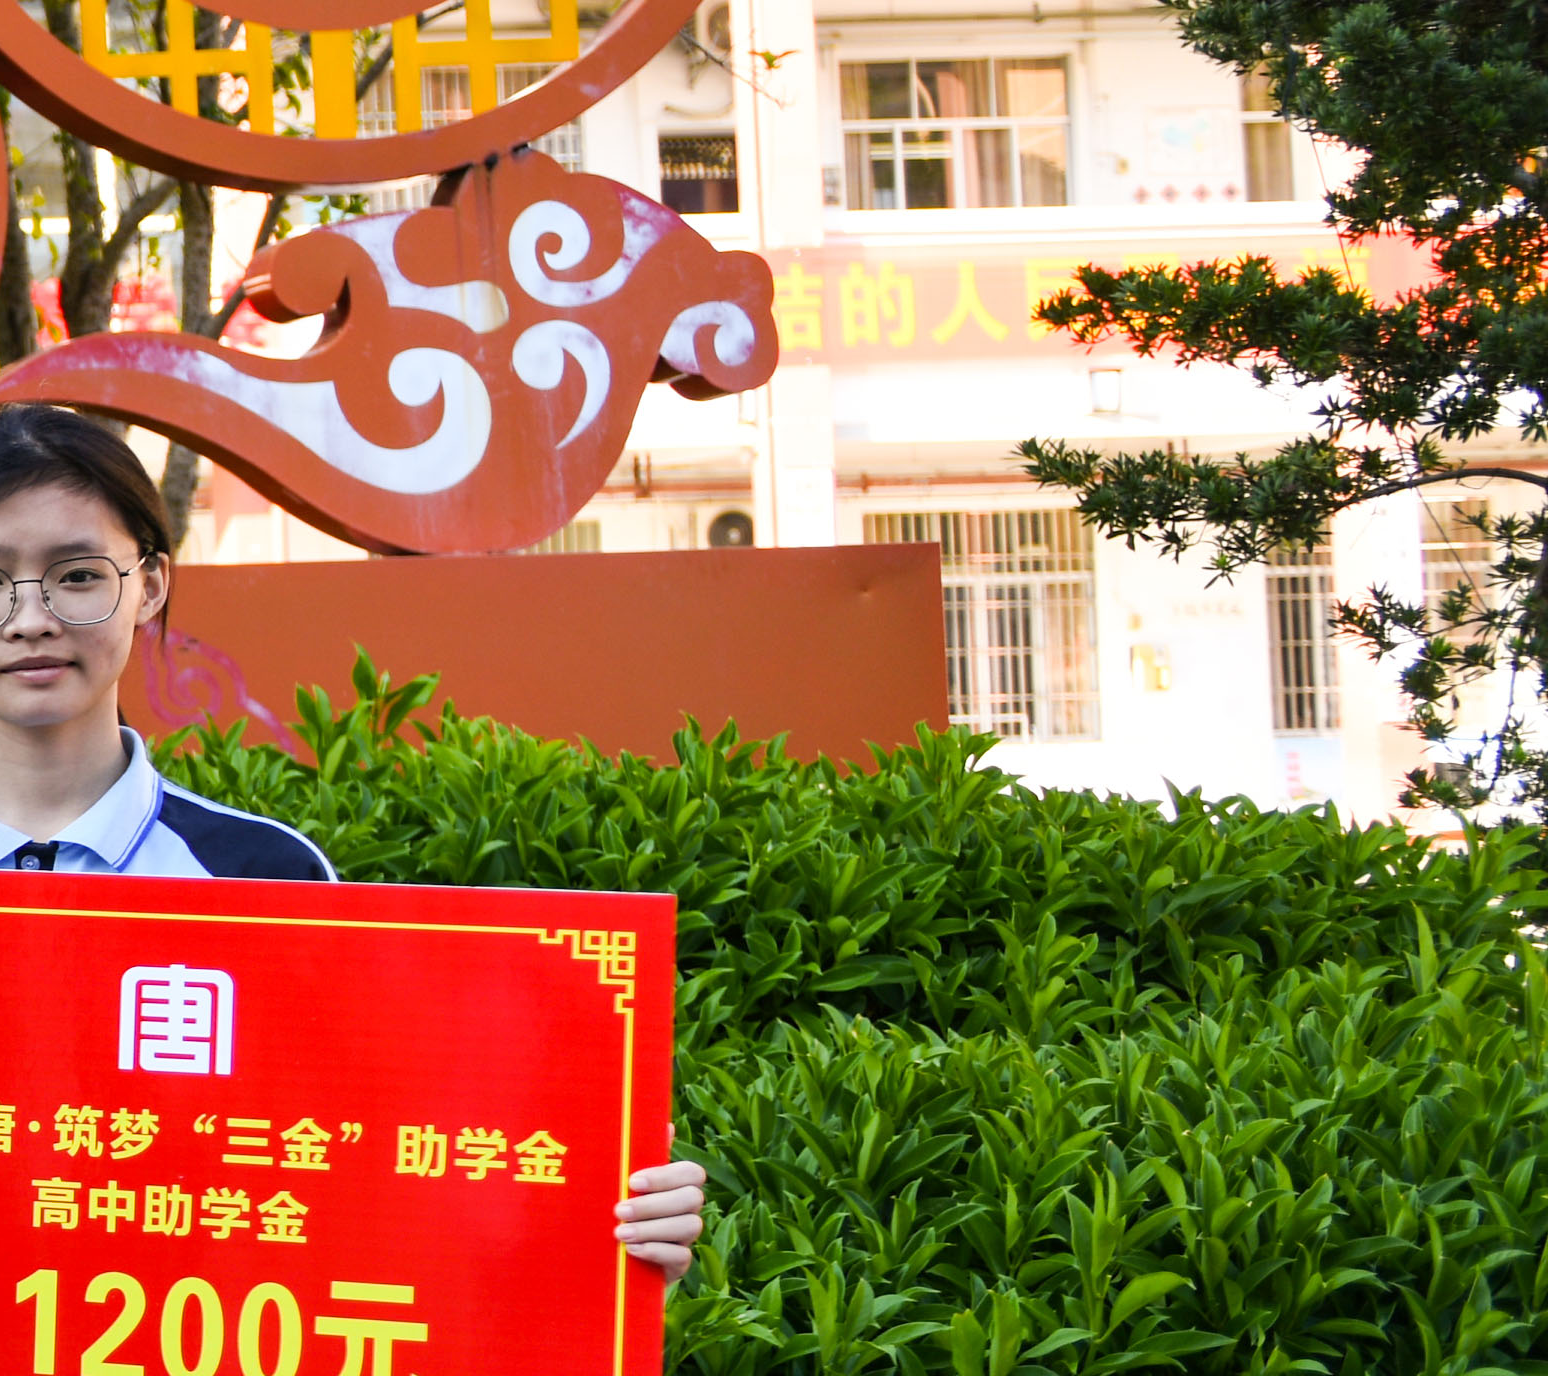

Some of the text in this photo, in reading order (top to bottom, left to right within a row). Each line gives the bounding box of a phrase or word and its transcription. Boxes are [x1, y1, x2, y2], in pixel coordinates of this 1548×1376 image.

[118, 963, 233, 1076] 唐
[31, 1177, 309, 1243] 高中助学金
